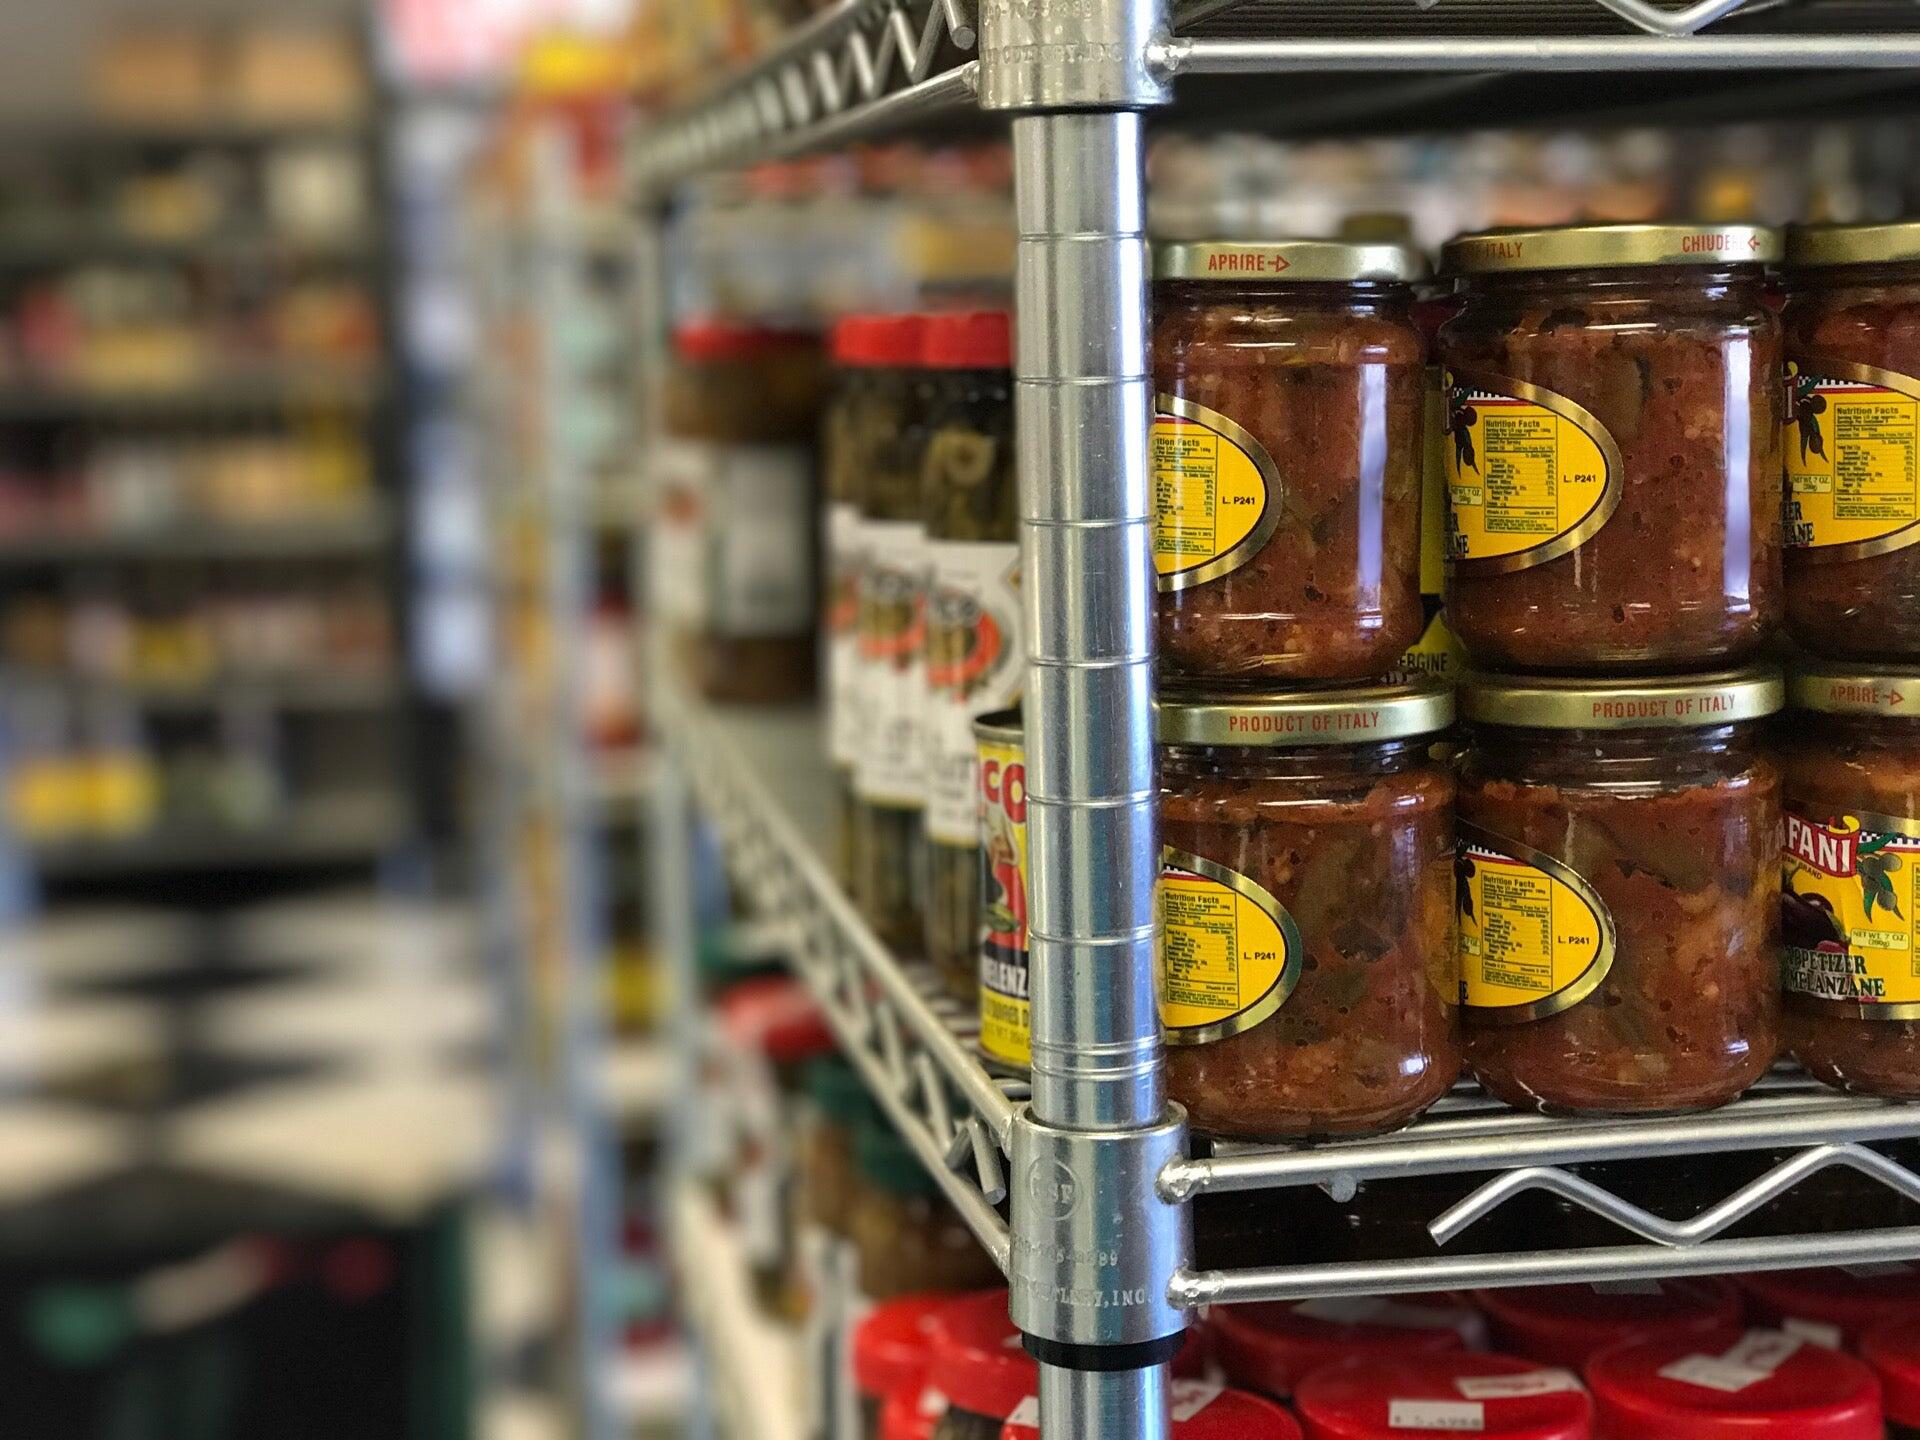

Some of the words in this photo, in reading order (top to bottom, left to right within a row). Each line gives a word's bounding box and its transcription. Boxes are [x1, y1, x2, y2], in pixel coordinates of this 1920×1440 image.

[1683, 235, 1744, 252] CHIUDE
[1486, 242, 1522, 258] ITALY
[1208, 254, 1265, 271] APRIRE
[1836, 407, 1872, 415] Nutrition
[1874, 406, 1899, 414] Facts
[1485, 420, 1516, 428] Nutrition
[1177, 438, 1200, 446] Facts
[1564, 475, 1571, 483] L.
[1575, 475, 1597, 483] P241
[1222, 496, 1231, 504] L.
[1234, 496, 1255, 504] P241
[1830, 685, 1879, 704] APRIRE
[1593, 700, 1668, 719] PRODUCT
[1675, 699, 1693, 716] OF
[1699, 694, 1736, 713] ITALY
[1229, 715, 1305, 733] PRODUCT
[1312, 714, 1330, 731] OF
[1337, 711, 1380, 729] ITALY
[1484, 875, 1513, 886] Nutrition
[1514, 879, 1536, 889] Facts
[1165, 892, 1196, 902] Nutrition
[1198, 895, 1220, 904] Facts
[1558, 935, 1566, 944] L.
[1569, 936, 1590, 945] P241
[1243, 951, 1251, 960] L.
[1254, 952, 1276, 960] P241
